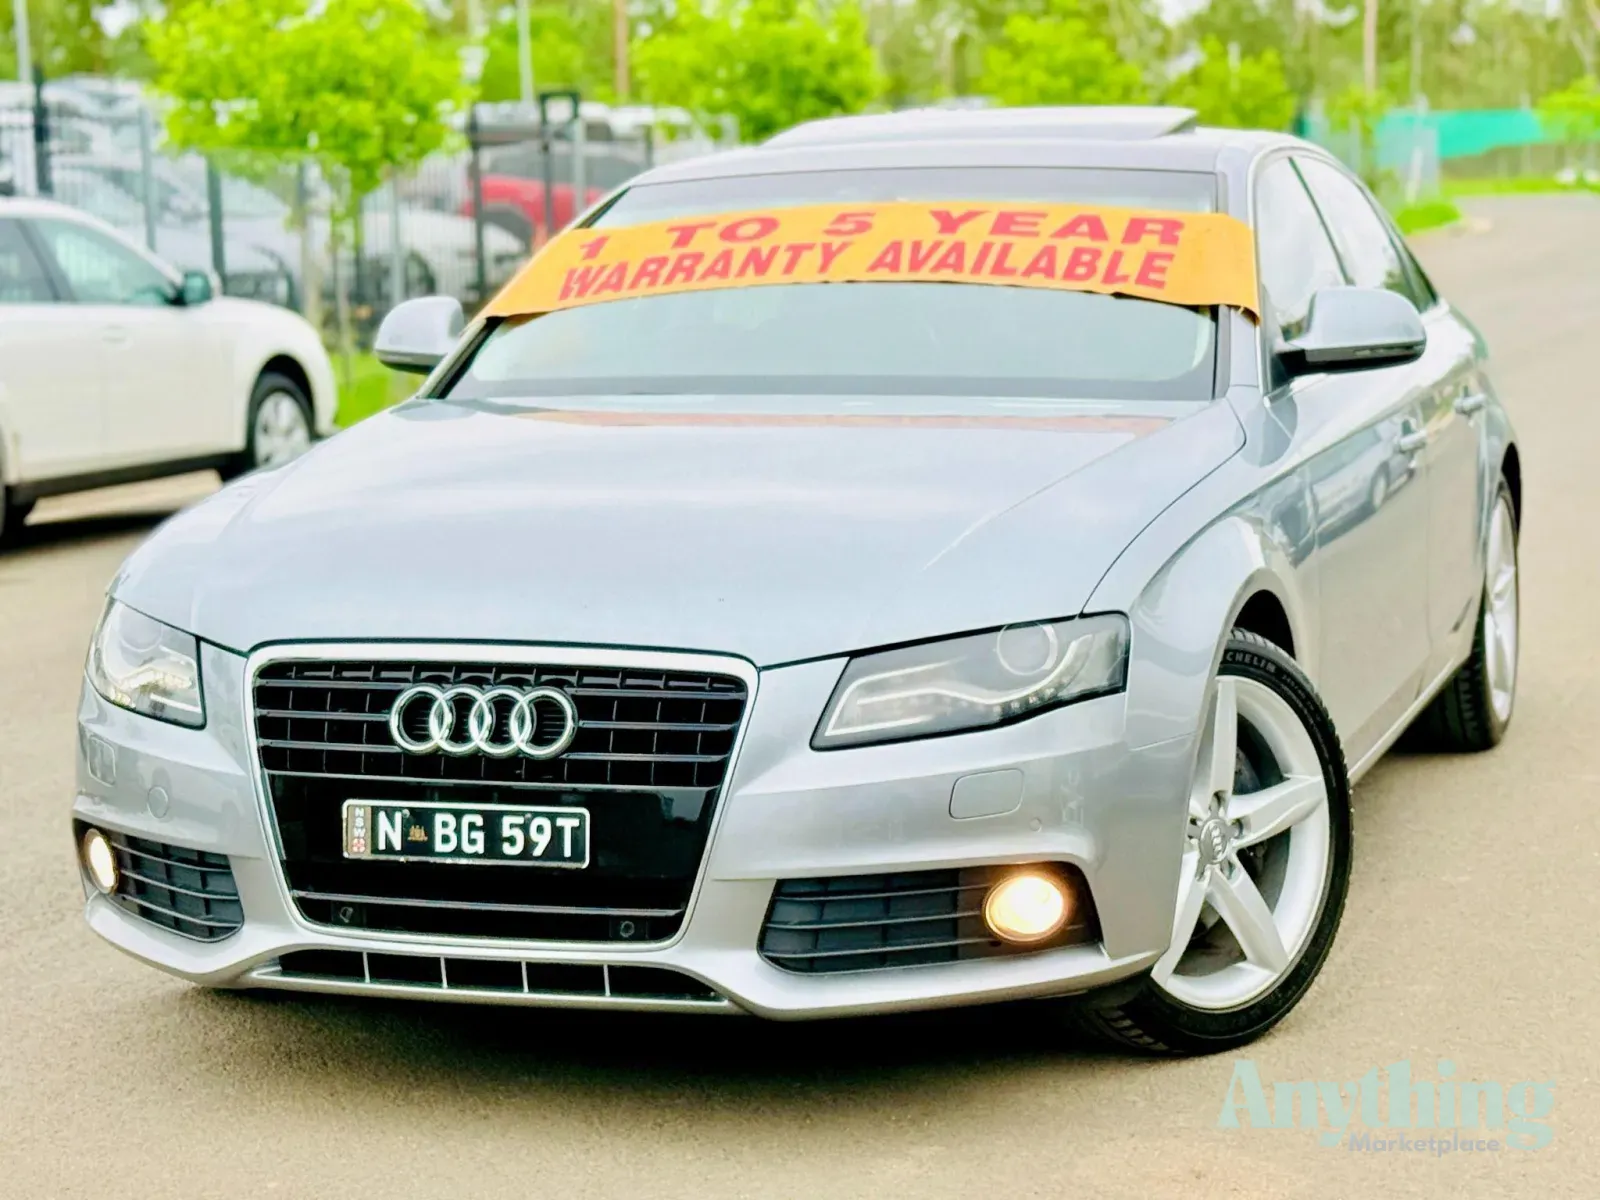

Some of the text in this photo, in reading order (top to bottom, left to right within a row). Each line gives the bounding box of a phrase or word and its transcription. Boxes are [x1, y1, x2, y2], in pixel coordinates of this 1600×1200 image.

[580, 210, 1185, 260] 1 TO 5 YEAR
[558, 240, 1175, 301] WARRANTY AVAILABLE
[1226, 651, 1276, 673] CHELIN
[354, 806, 366, 838] NSW
[377, 811, 581, 858] N BG 59T
